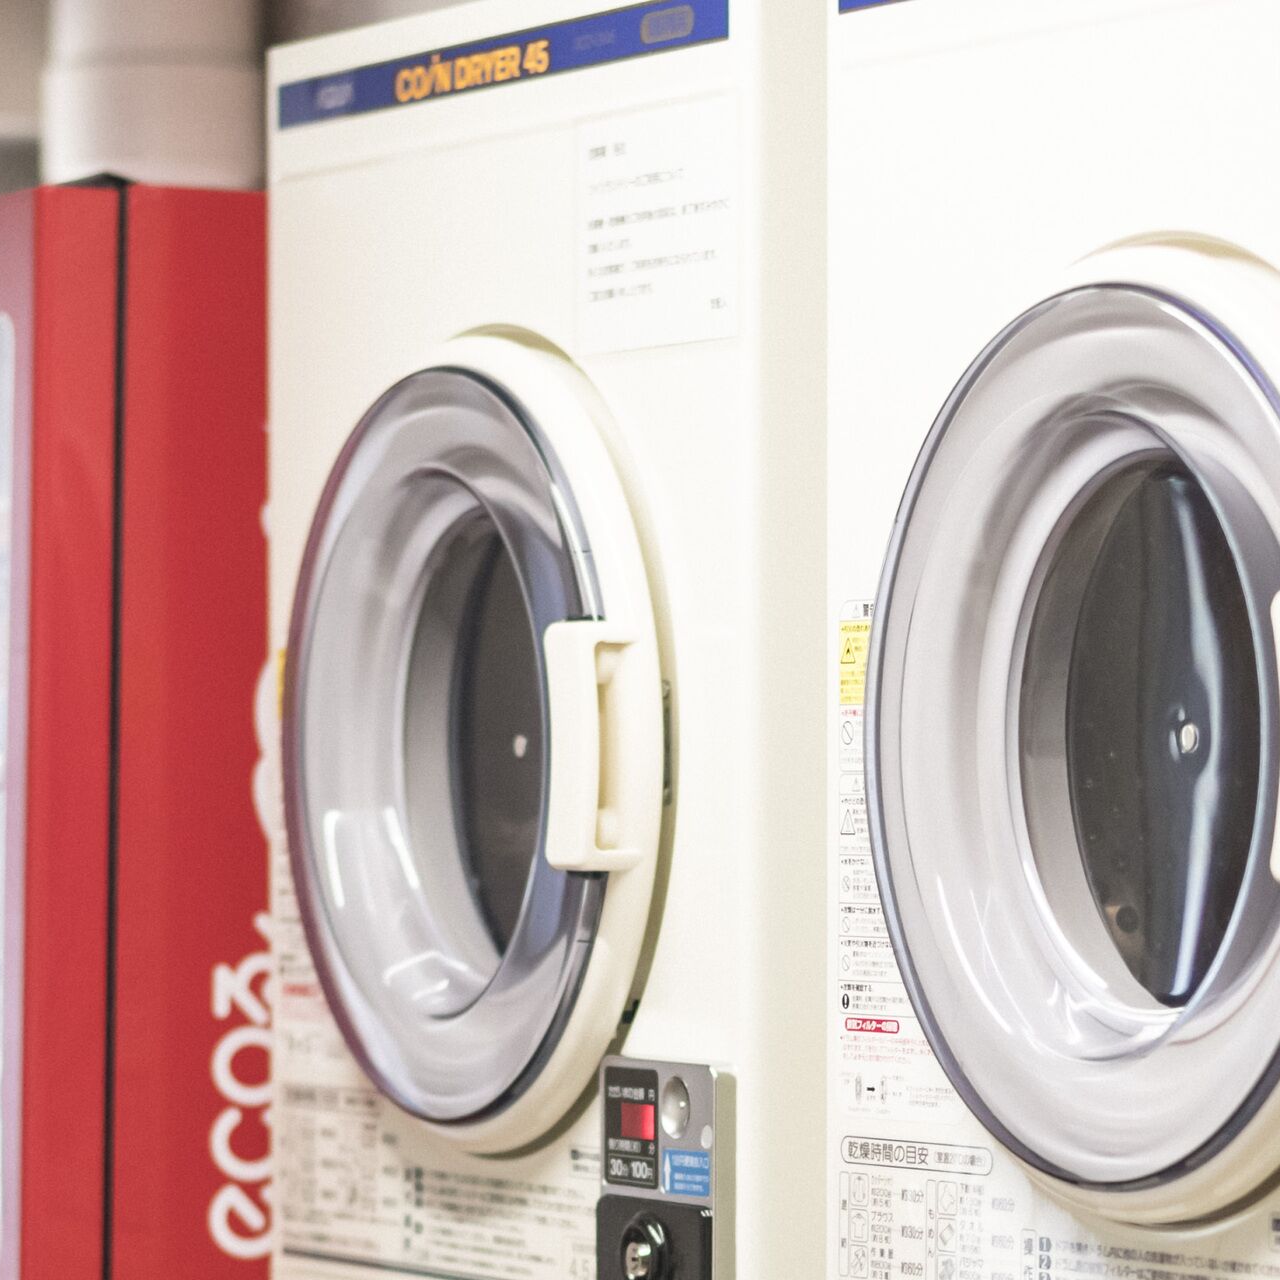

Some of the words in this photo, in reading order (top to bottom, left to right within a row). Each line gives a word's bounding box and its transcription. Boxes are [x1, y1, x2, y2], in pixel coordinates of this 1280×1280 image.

[454, 46, 521, 91] DRYER
[523, 39, 550, 74] 45
[847, 1140, 929, 1166] 乾燥時間の目安
